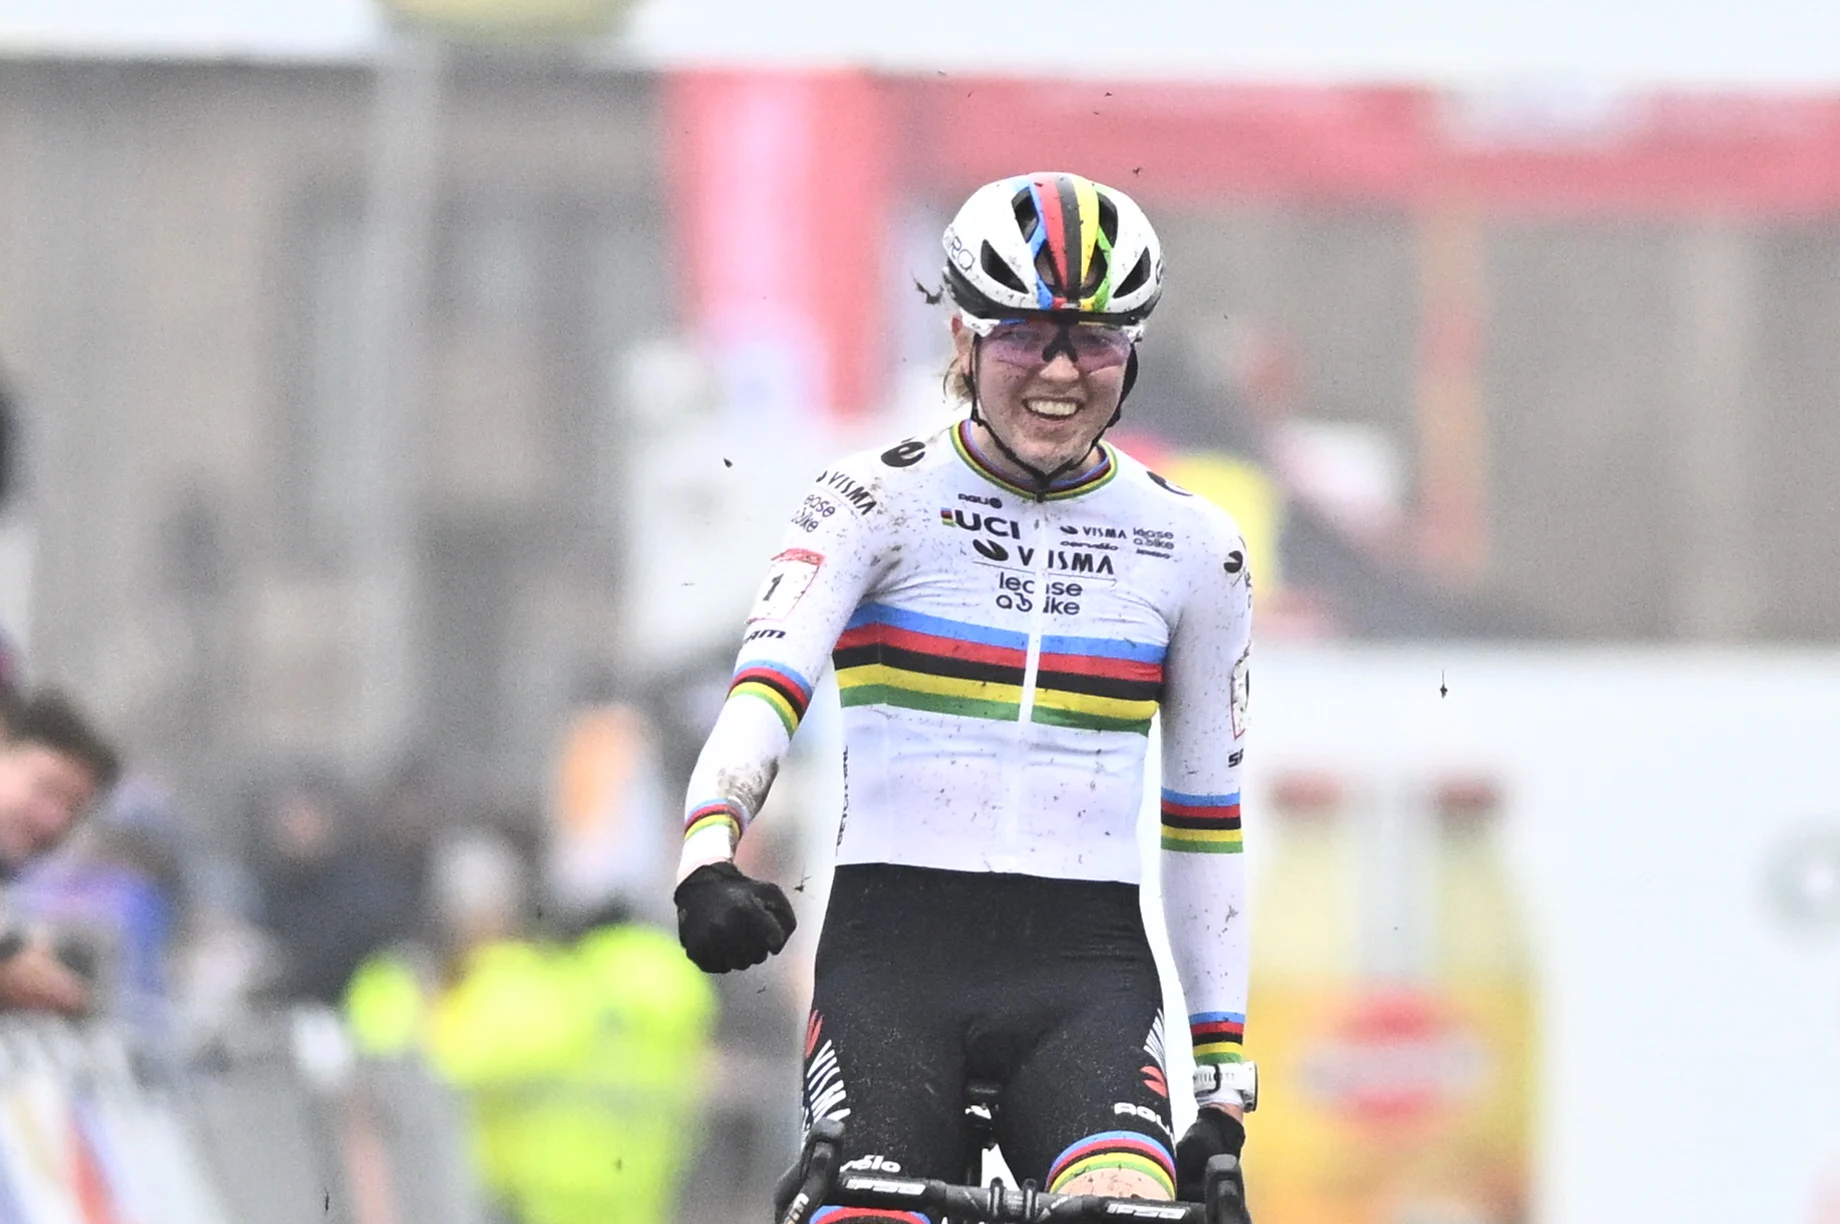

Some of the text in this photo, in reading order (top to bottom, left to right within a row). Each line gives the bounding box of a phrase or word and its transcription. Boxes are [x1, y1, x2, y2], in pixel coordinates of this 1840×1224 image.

[804, 494, 836, 517] ease
[827, 471, 877, 516] VISMA
[955, 509, 1021, 540] UCI
[1082, 526, 1127, 540] VISMA
[1018, 545, 1115, 575] VISMA
[762, 573, 785, 601] 1
